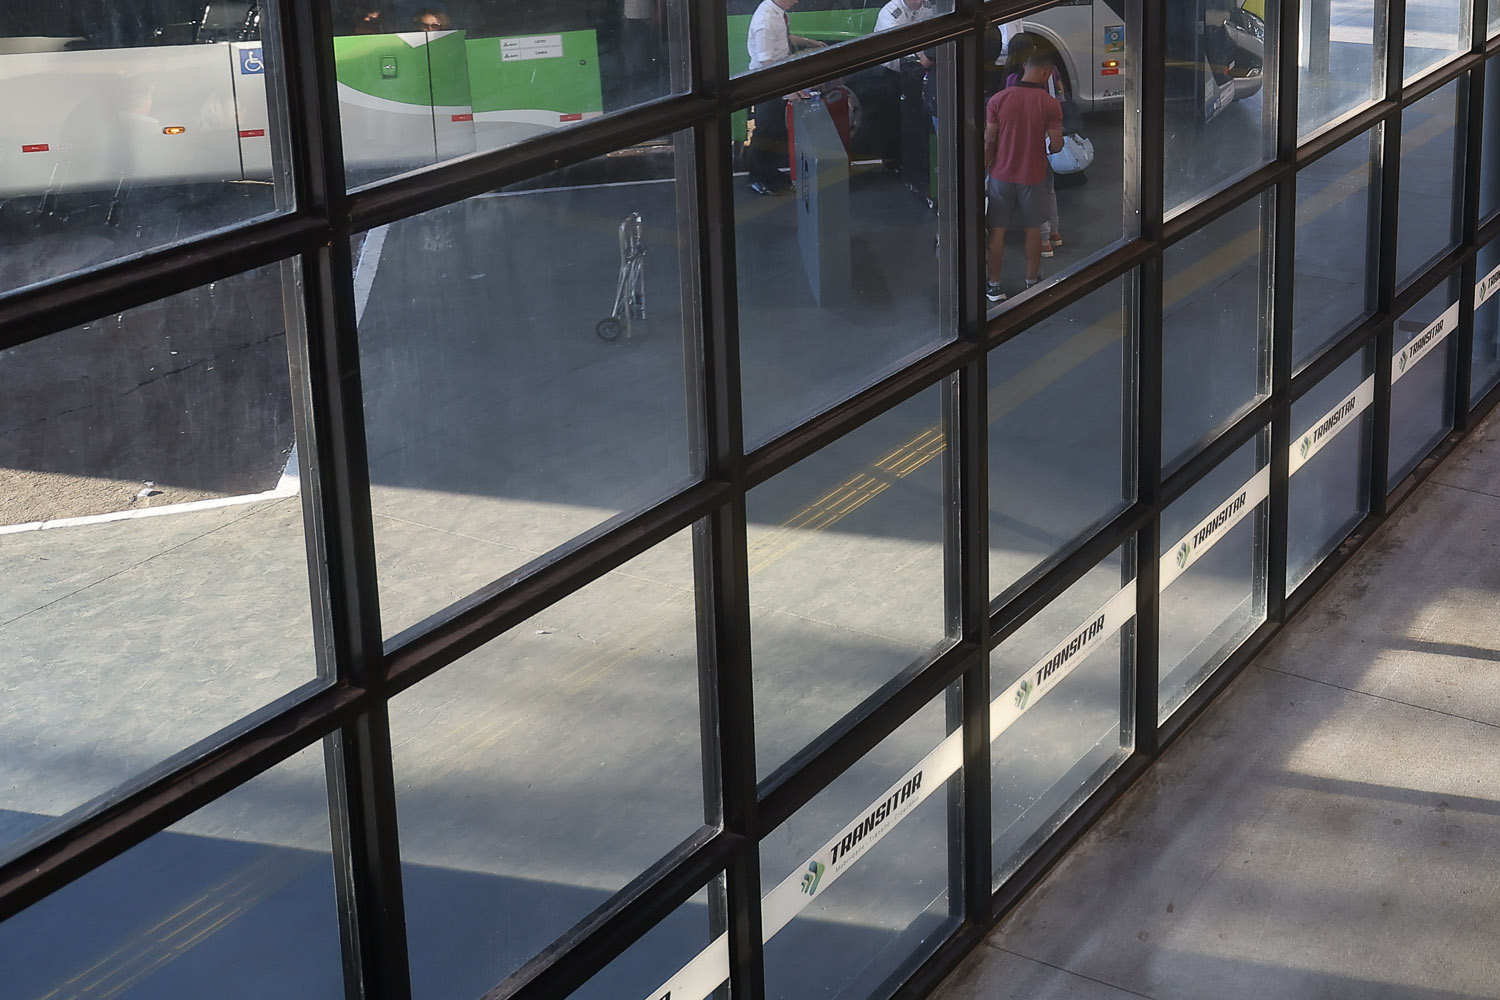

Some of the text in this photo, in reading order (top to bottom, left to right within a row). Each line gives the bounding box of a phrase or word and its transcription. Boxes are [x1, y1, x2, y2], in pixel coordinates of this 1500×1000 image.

[1409, 318, 1444, 358] TRANSITAR
[1313, 396, 1356, 444] TRANSITAR
[1193, 491, 1247, 549] TRANSITAR
[1036, 613, 1105, 687] TRANSITAR
[830, 770, 923, 866] TRANSITAR
